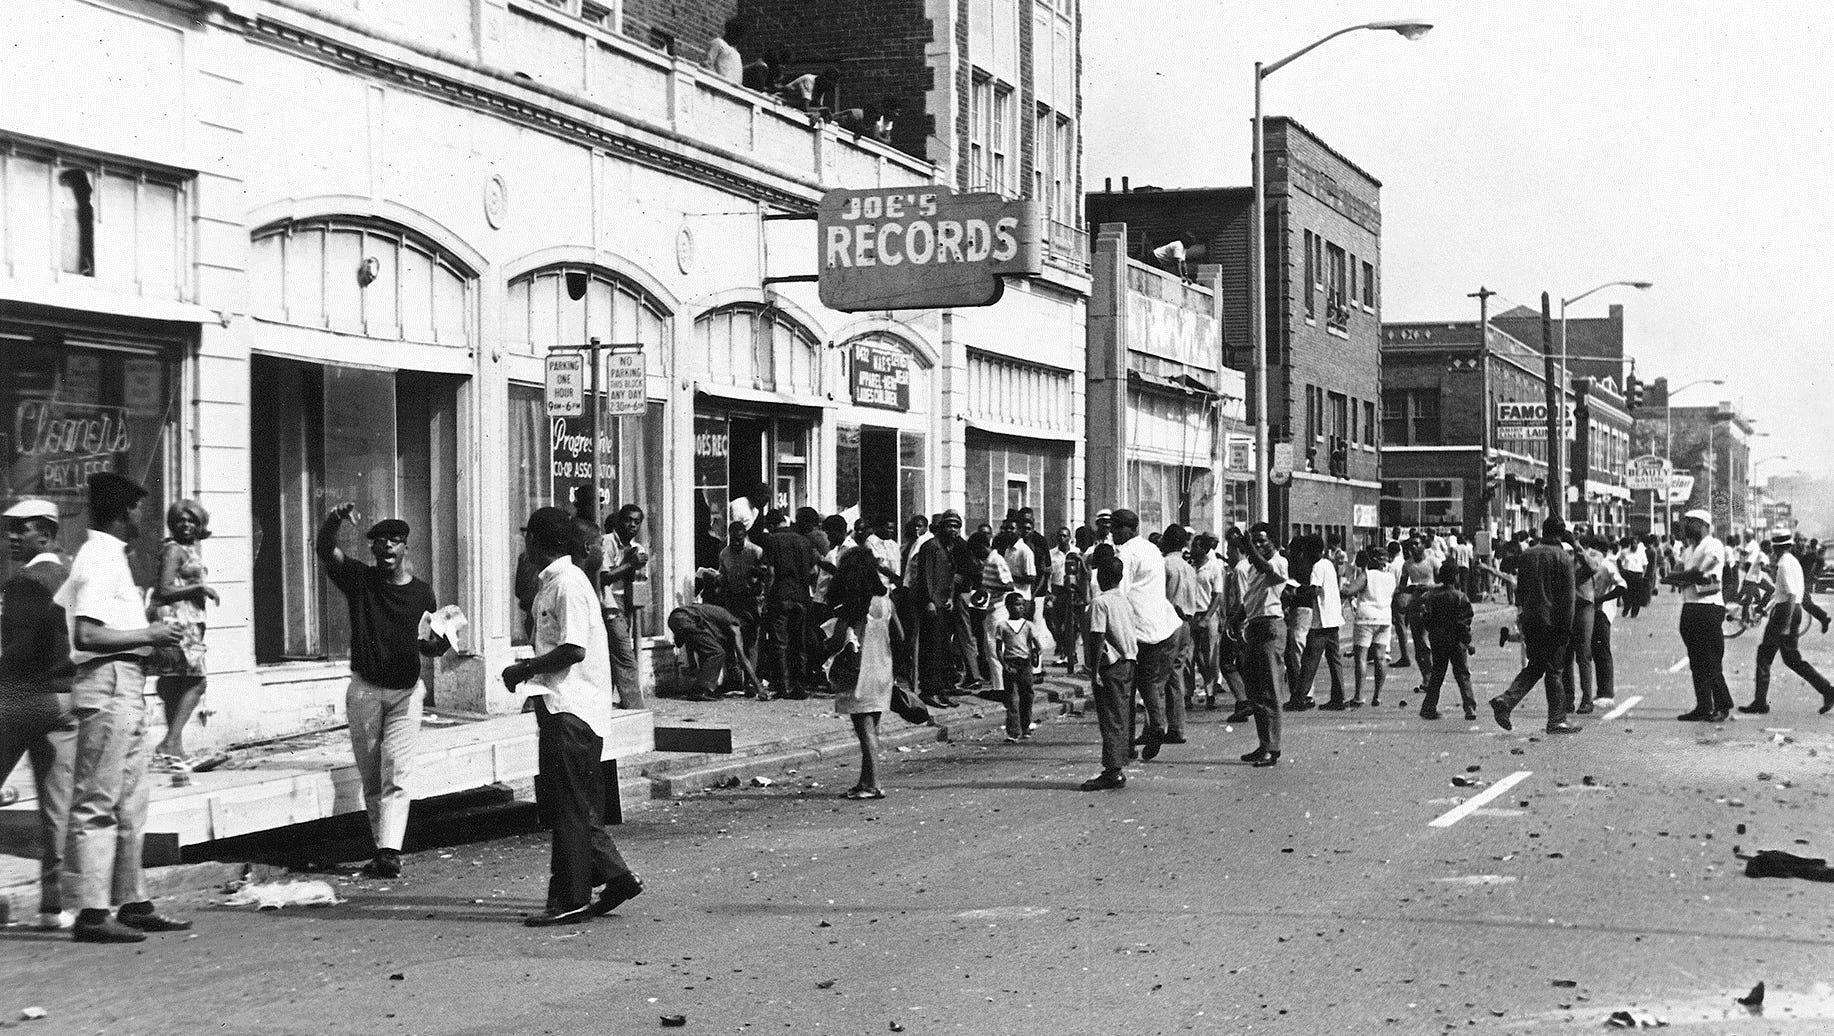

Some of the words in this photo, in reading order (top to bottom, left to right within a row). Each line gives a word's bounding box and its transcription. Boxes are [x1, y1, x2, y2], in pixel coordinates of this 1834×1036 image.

[842, 193, 937, 221] JOE'S
[827, 217, 1019, 268] RECORDS
[549, 361, 580, 371] PARKING
[619, 356, 632, 366] NO
[610, 368, 642, 378] PARKING
[556, 374, 571, 384] ONE
[554, 387, 574, 398] HOUR
[610, 389, 625, 399] ANY
[627, 389, 642, 399] DAY
[554, 461, 573, 478] CO-OP
[1628, 468, 1670, 477] BEAUTY
